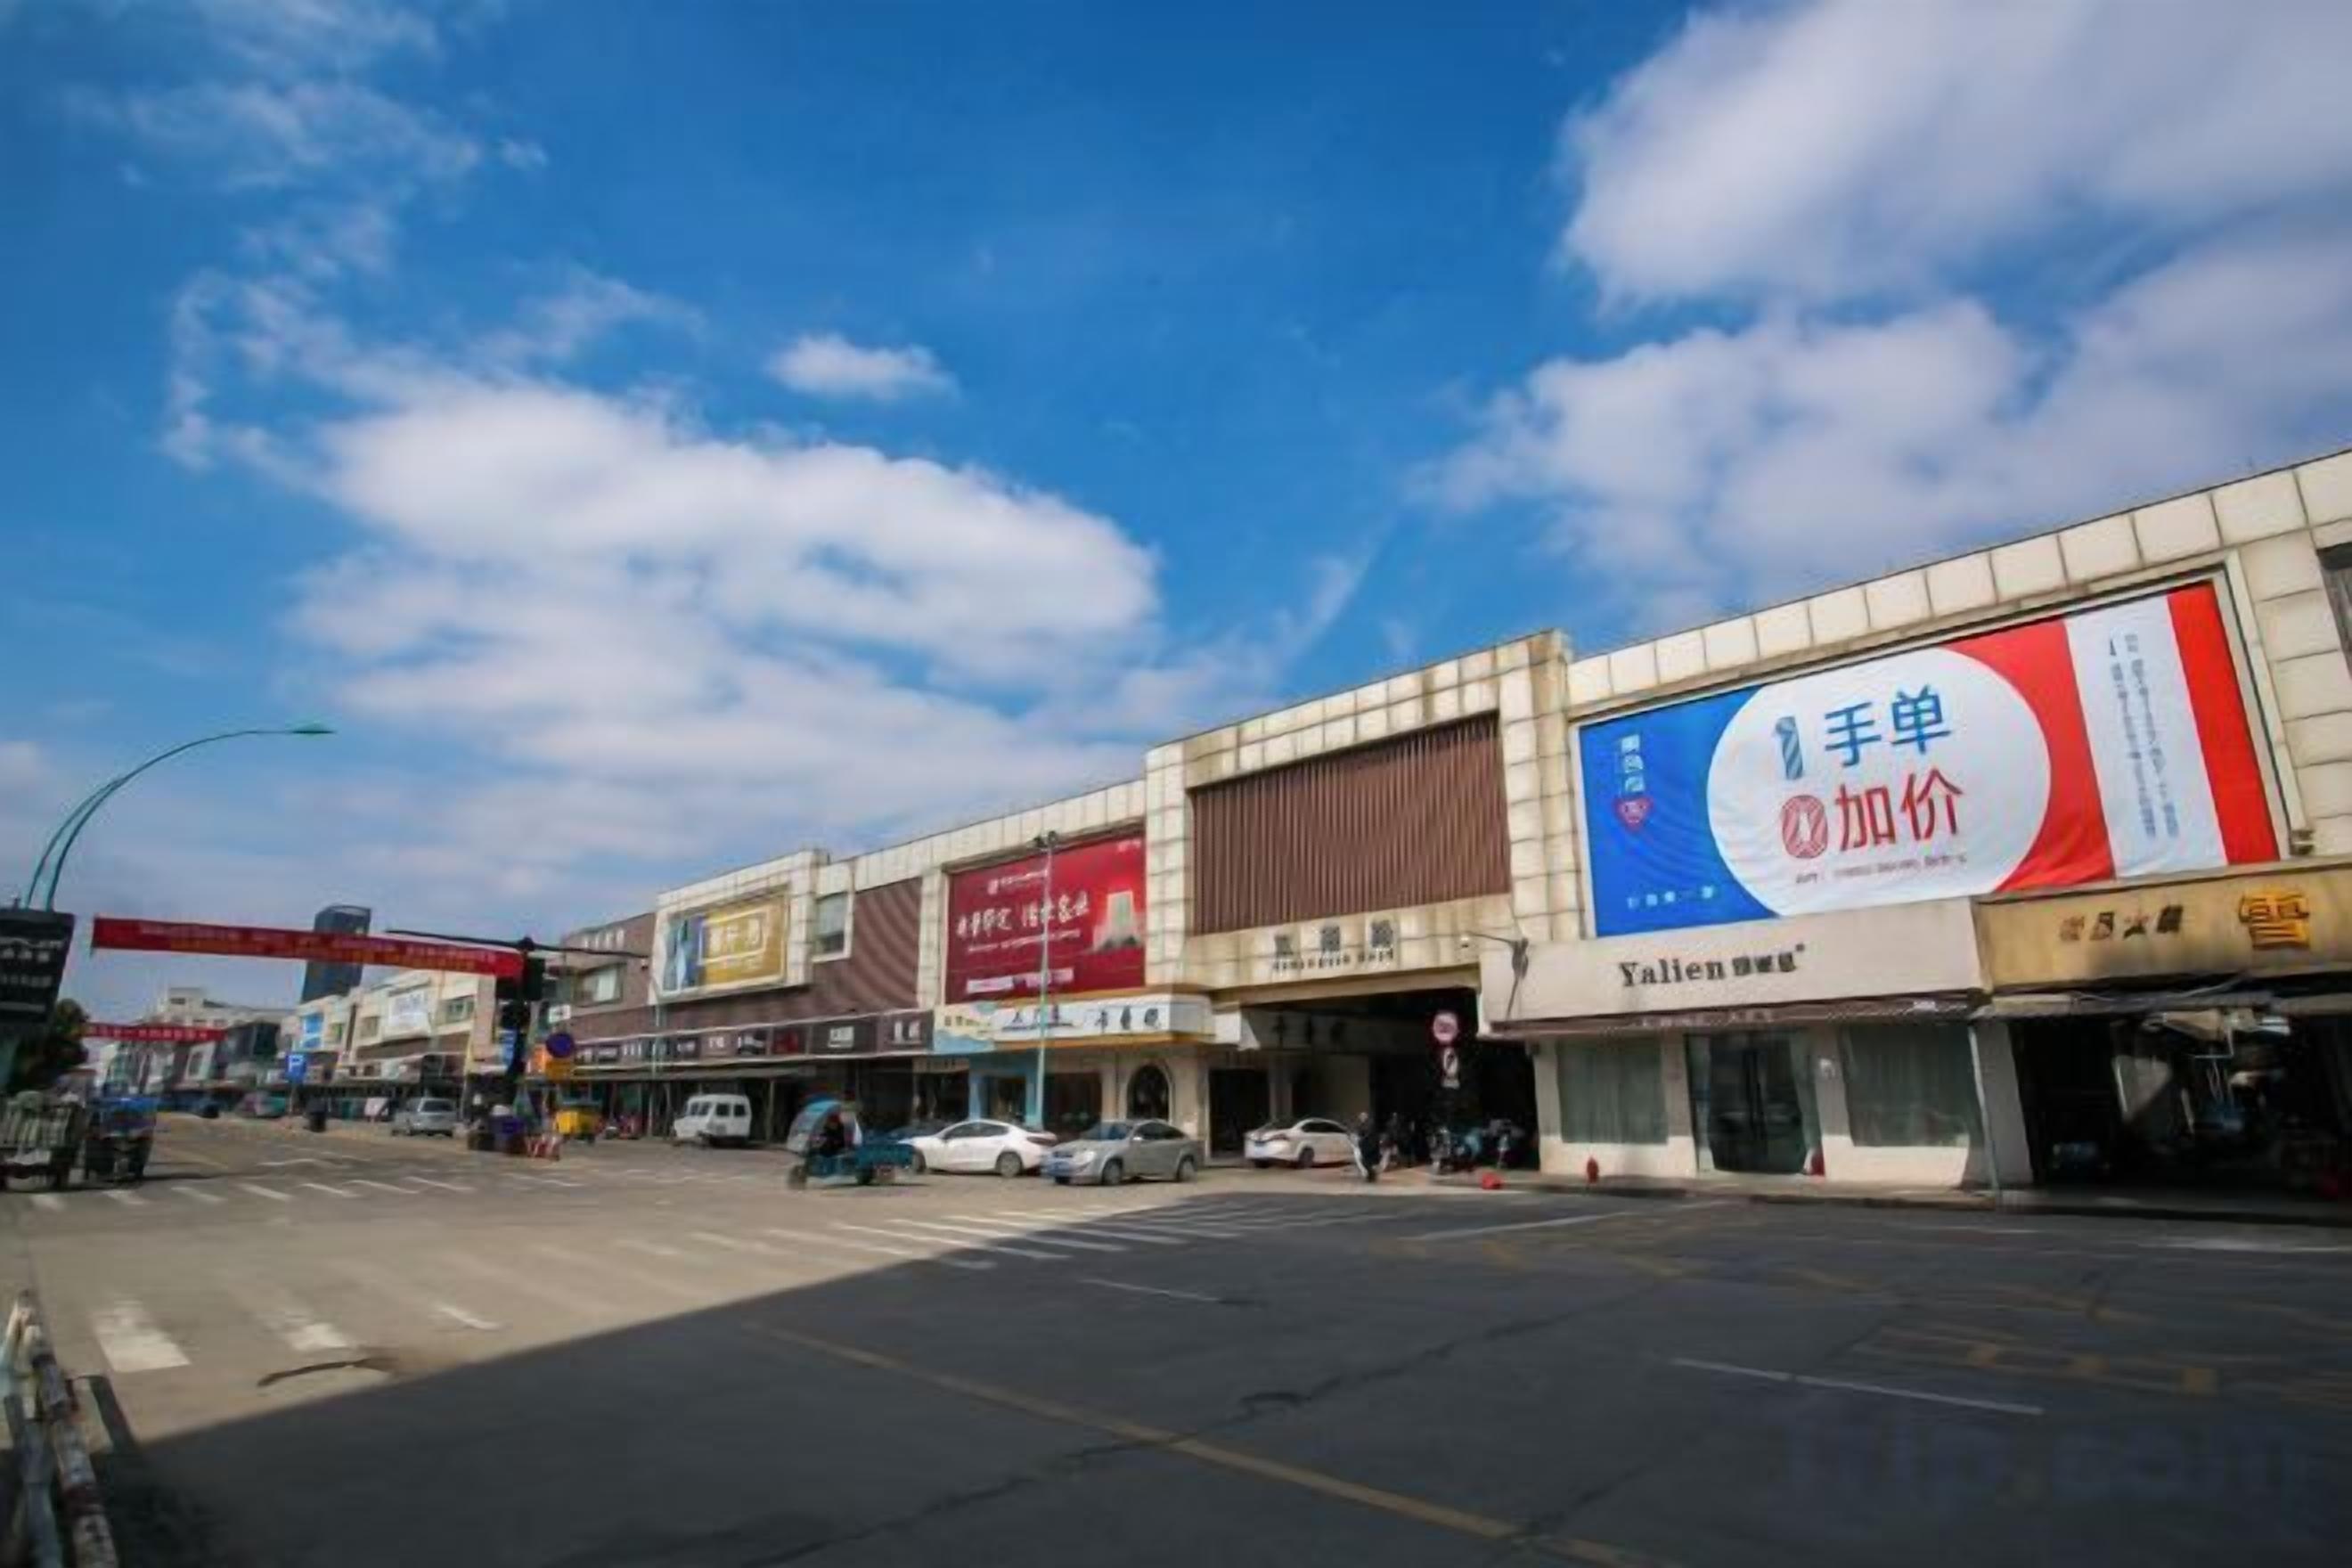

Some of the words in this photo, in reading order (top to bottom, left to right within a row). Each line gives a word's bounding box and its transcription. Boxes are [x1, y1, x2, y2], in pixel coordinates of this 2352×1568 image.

[1775, 684, 1952, 780] 1手单
[1782, 768, 1964, 859] 0加价
[1619, 957, 1726, 987] Yalien
